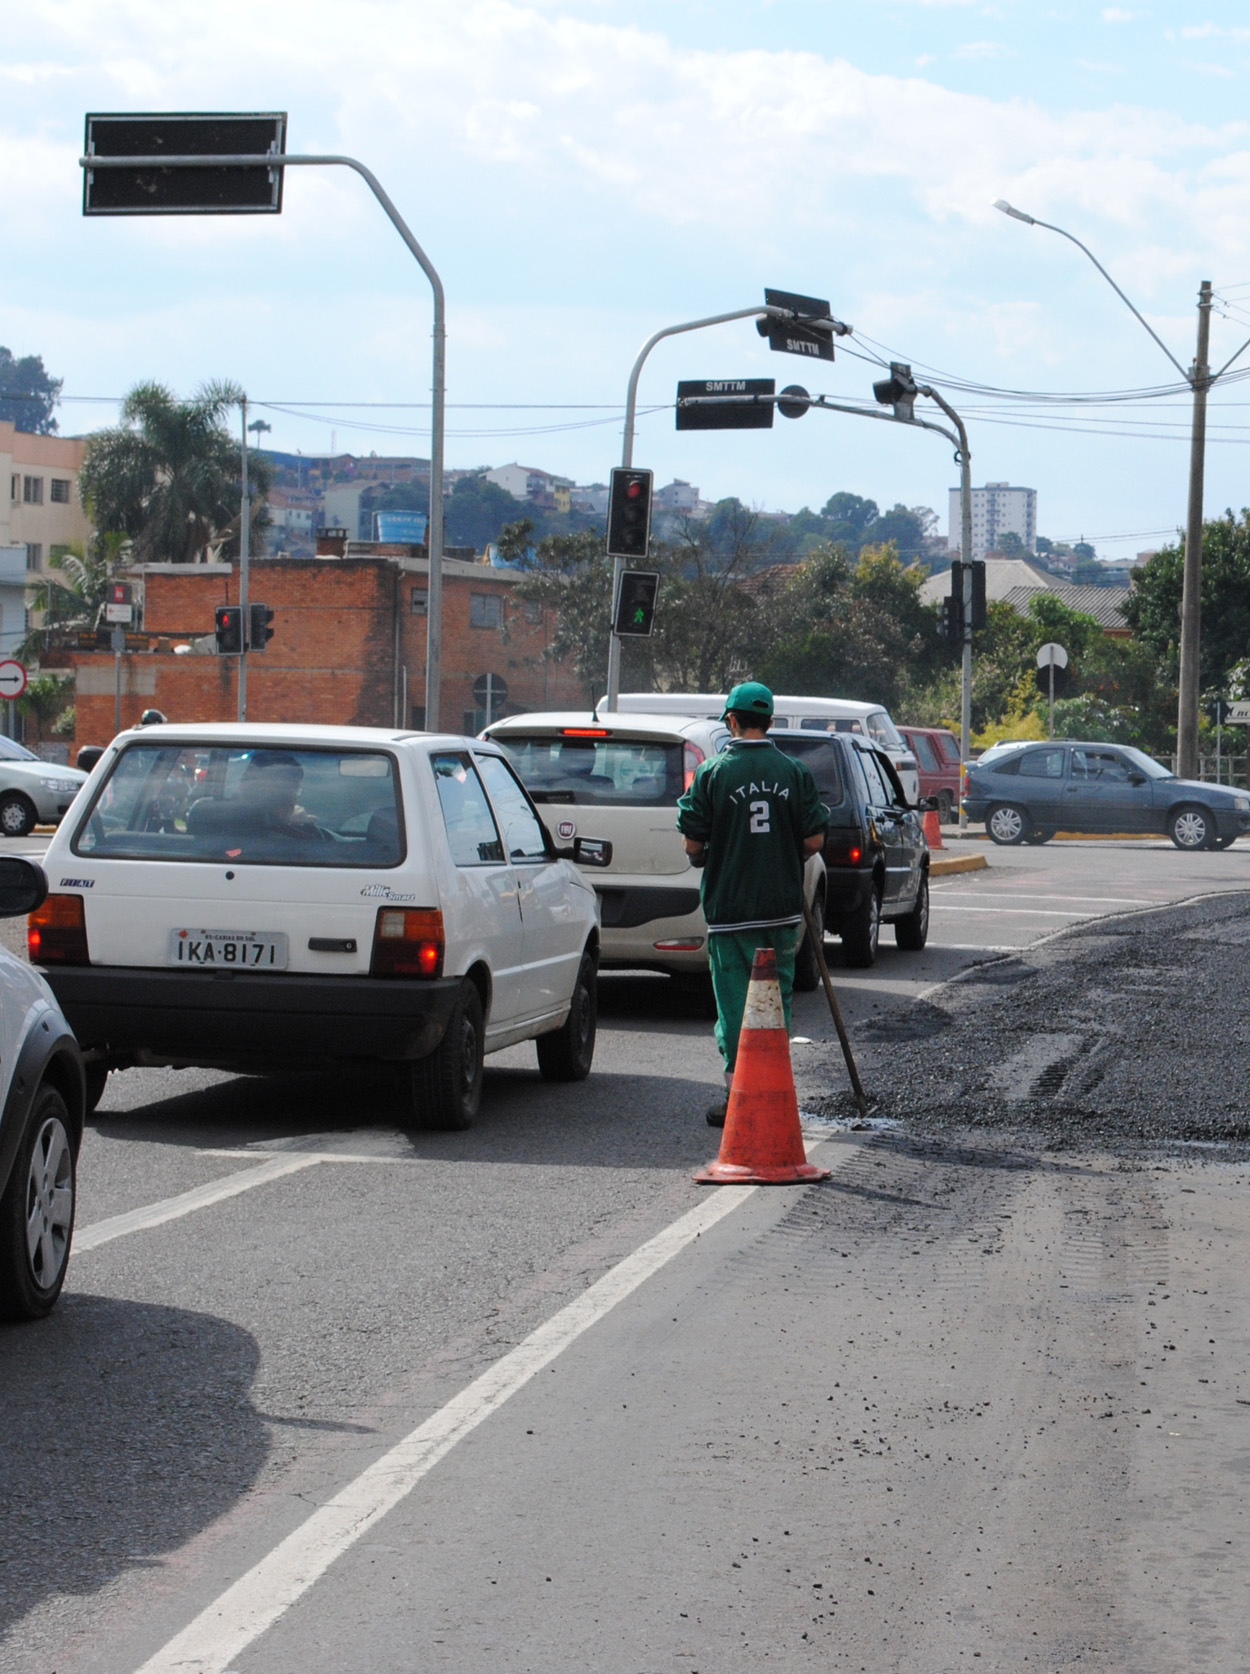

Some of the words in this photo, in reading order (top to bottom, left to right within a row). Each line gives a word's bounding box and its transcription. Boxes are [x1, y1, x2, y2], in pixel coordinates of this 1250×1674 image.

[786, 338, 820, 356] SMTTM
[705, 381, 746, 392] SMTTM
[729, 780, 790, 805] ITALIA
[749, 800, 770, 833] 2
[60, 878, 95, 888] FIAT
[360, 883, 391, 897] Mille
